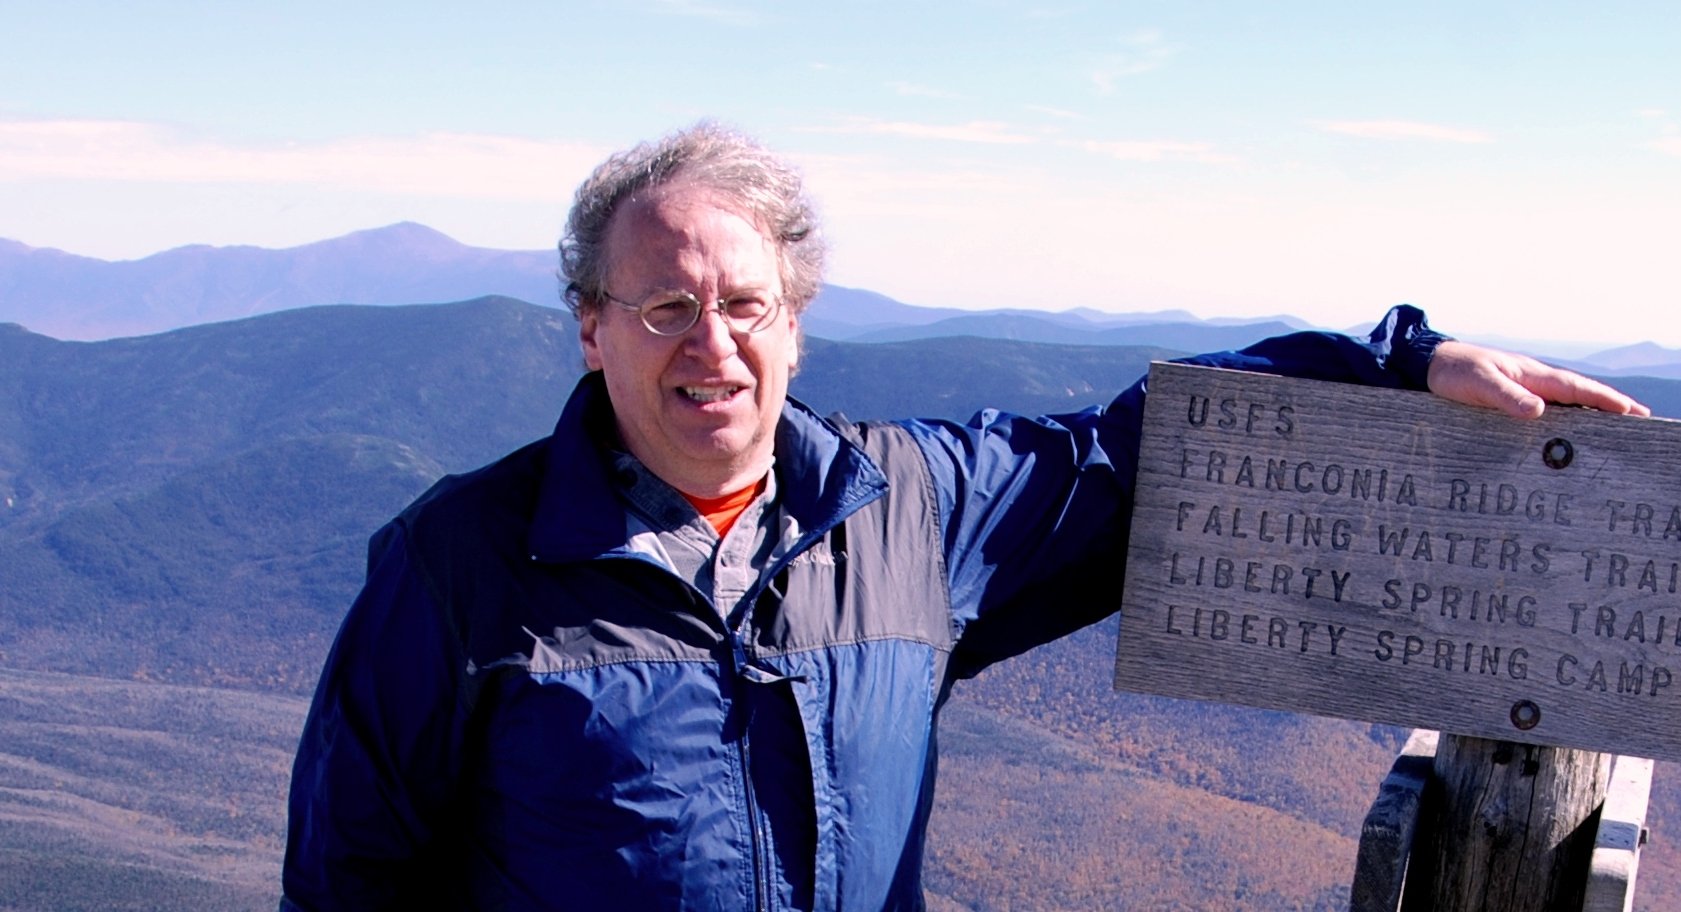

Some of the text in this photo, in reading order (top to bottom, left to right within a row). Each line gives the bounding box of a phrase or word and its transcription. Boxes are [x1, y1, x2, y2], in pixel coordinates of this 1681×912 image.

[1187, 395, 1295, 436] USFS
[1181, 449, 1417, 507] FRANCONIA
[1449, 478, 1574, 527] RIDGE
[1176, 501, 1351, 550] FALLING
[1378, 524, 1550, 574] WATERS
[1170, 552, 1350, 602] LIBERTY
[1382, 578, 1537, 627] SPRING
[1166, 604, 1672, 697] LIBERTY SPRING CAMP
